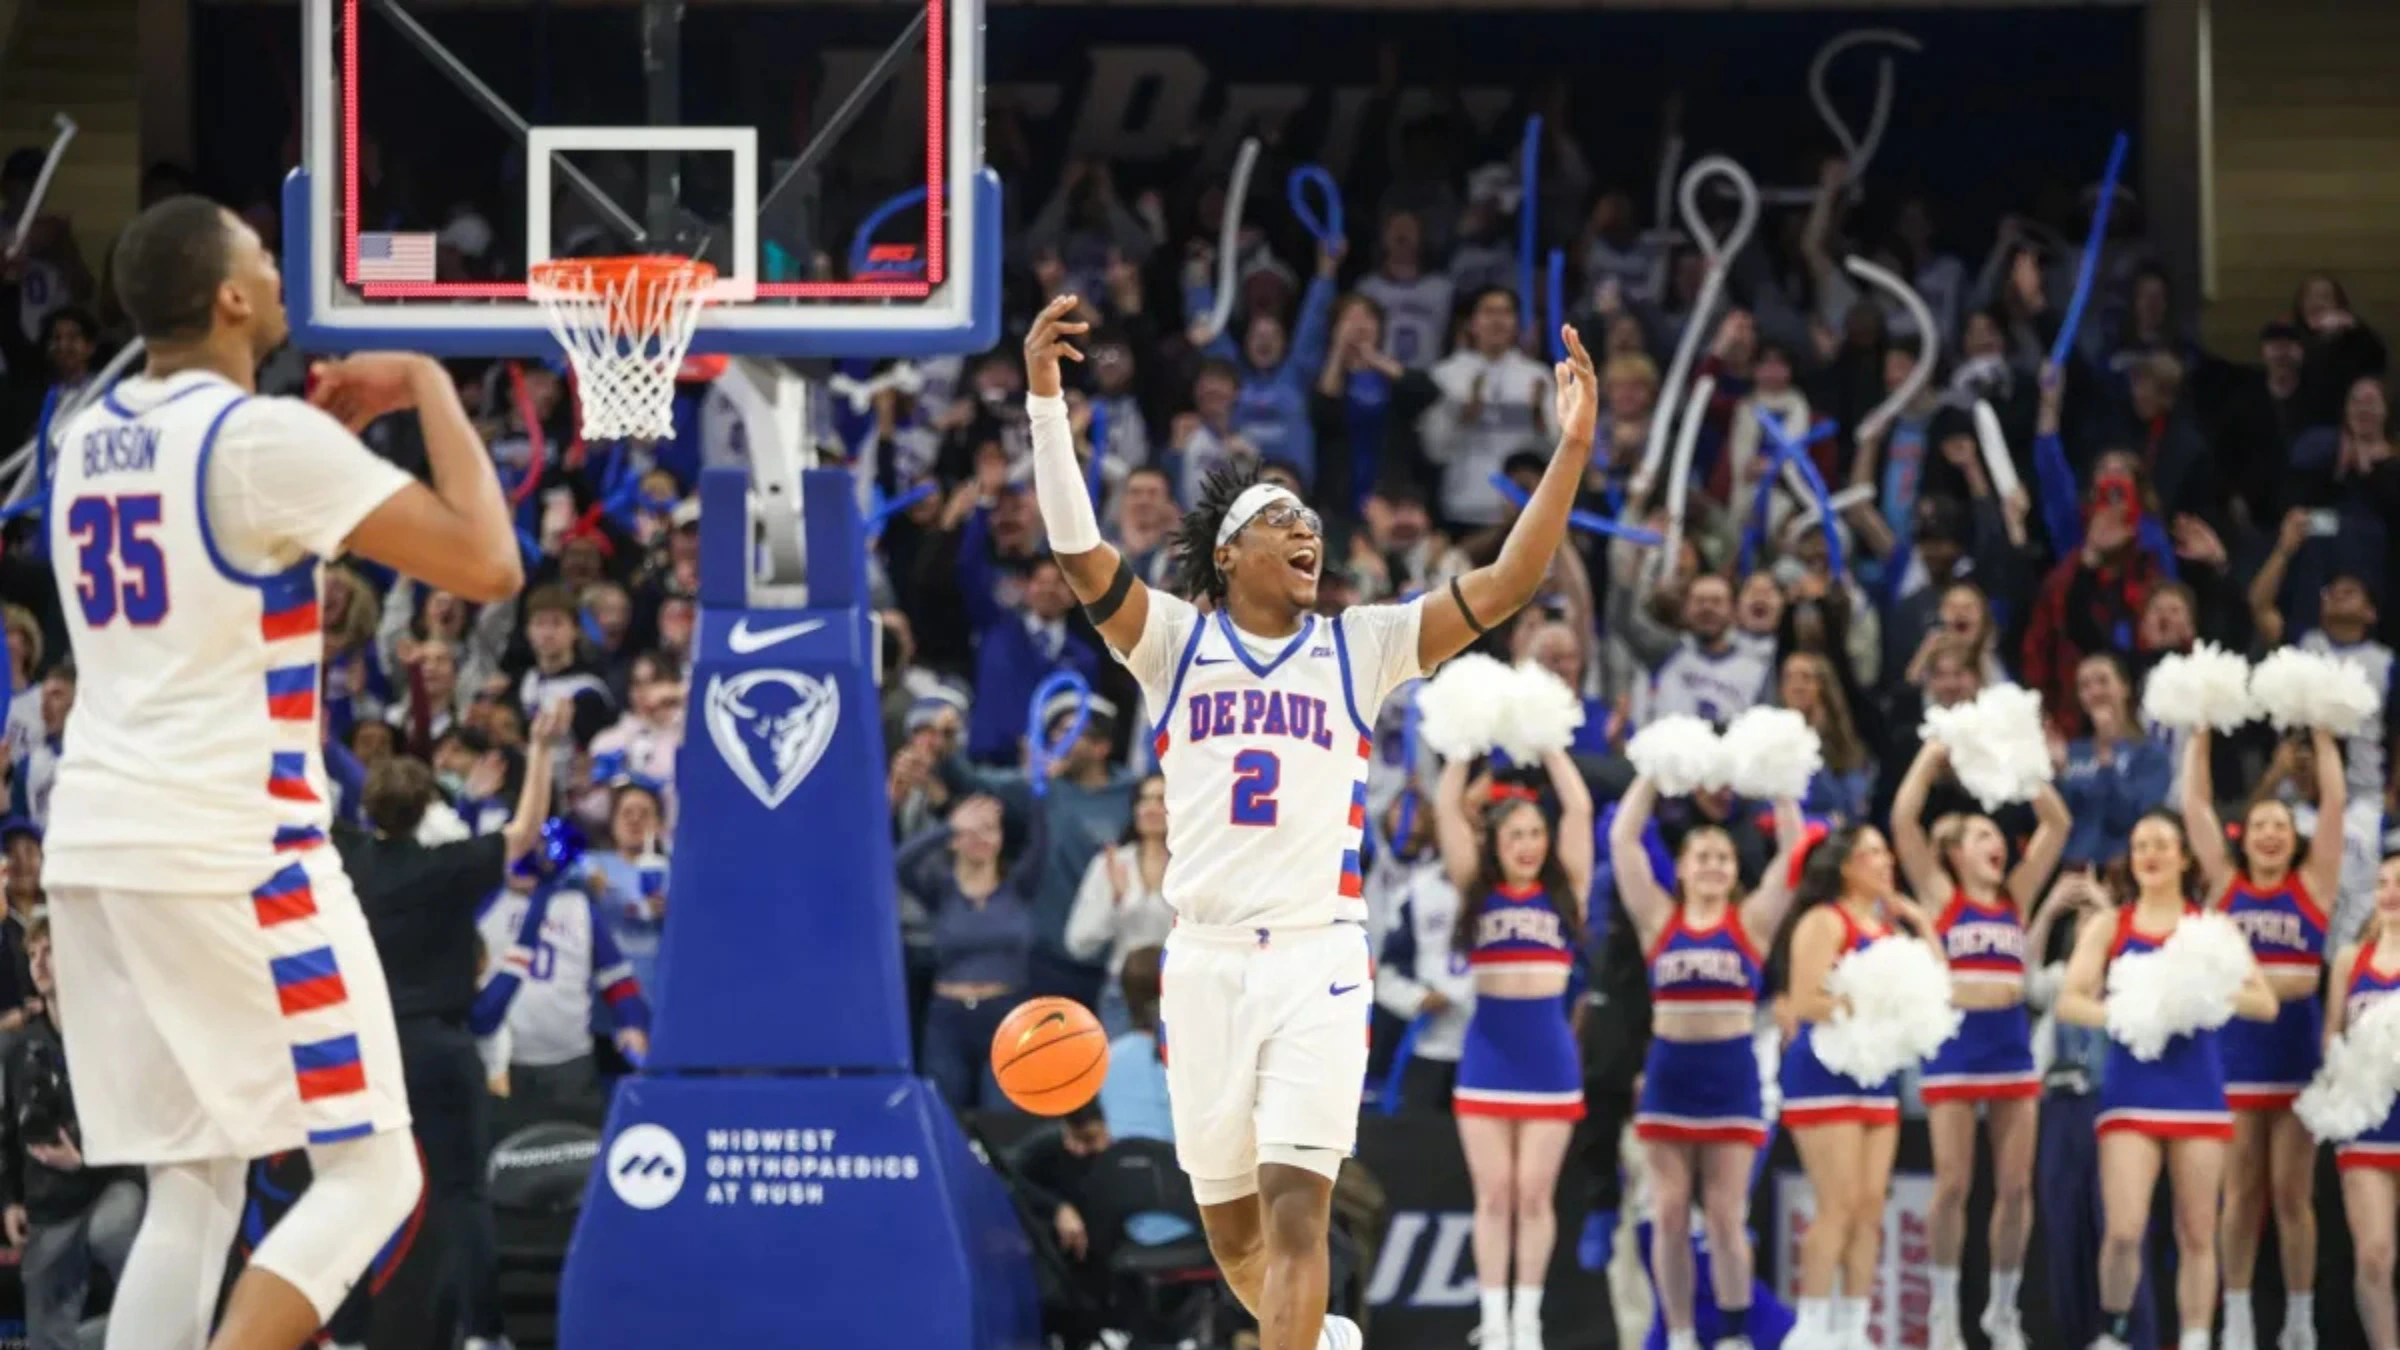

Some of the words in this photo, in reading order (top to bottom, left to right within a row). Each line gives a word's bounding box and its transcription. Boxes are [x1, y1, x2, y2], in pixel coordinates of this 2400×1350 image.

[83, 426, 160, 478] BENSON
[67, 493, 170, 628] 35
[1230, 748, 1280, 827] 2
[706, 1129, 835, 1152] MIDWEST
[706, 1155, 919, 1179] ORTHOPAEDICS
[706, 1181, 739, 1205] AT
[750, 1181, 824, 1205] RUSH
